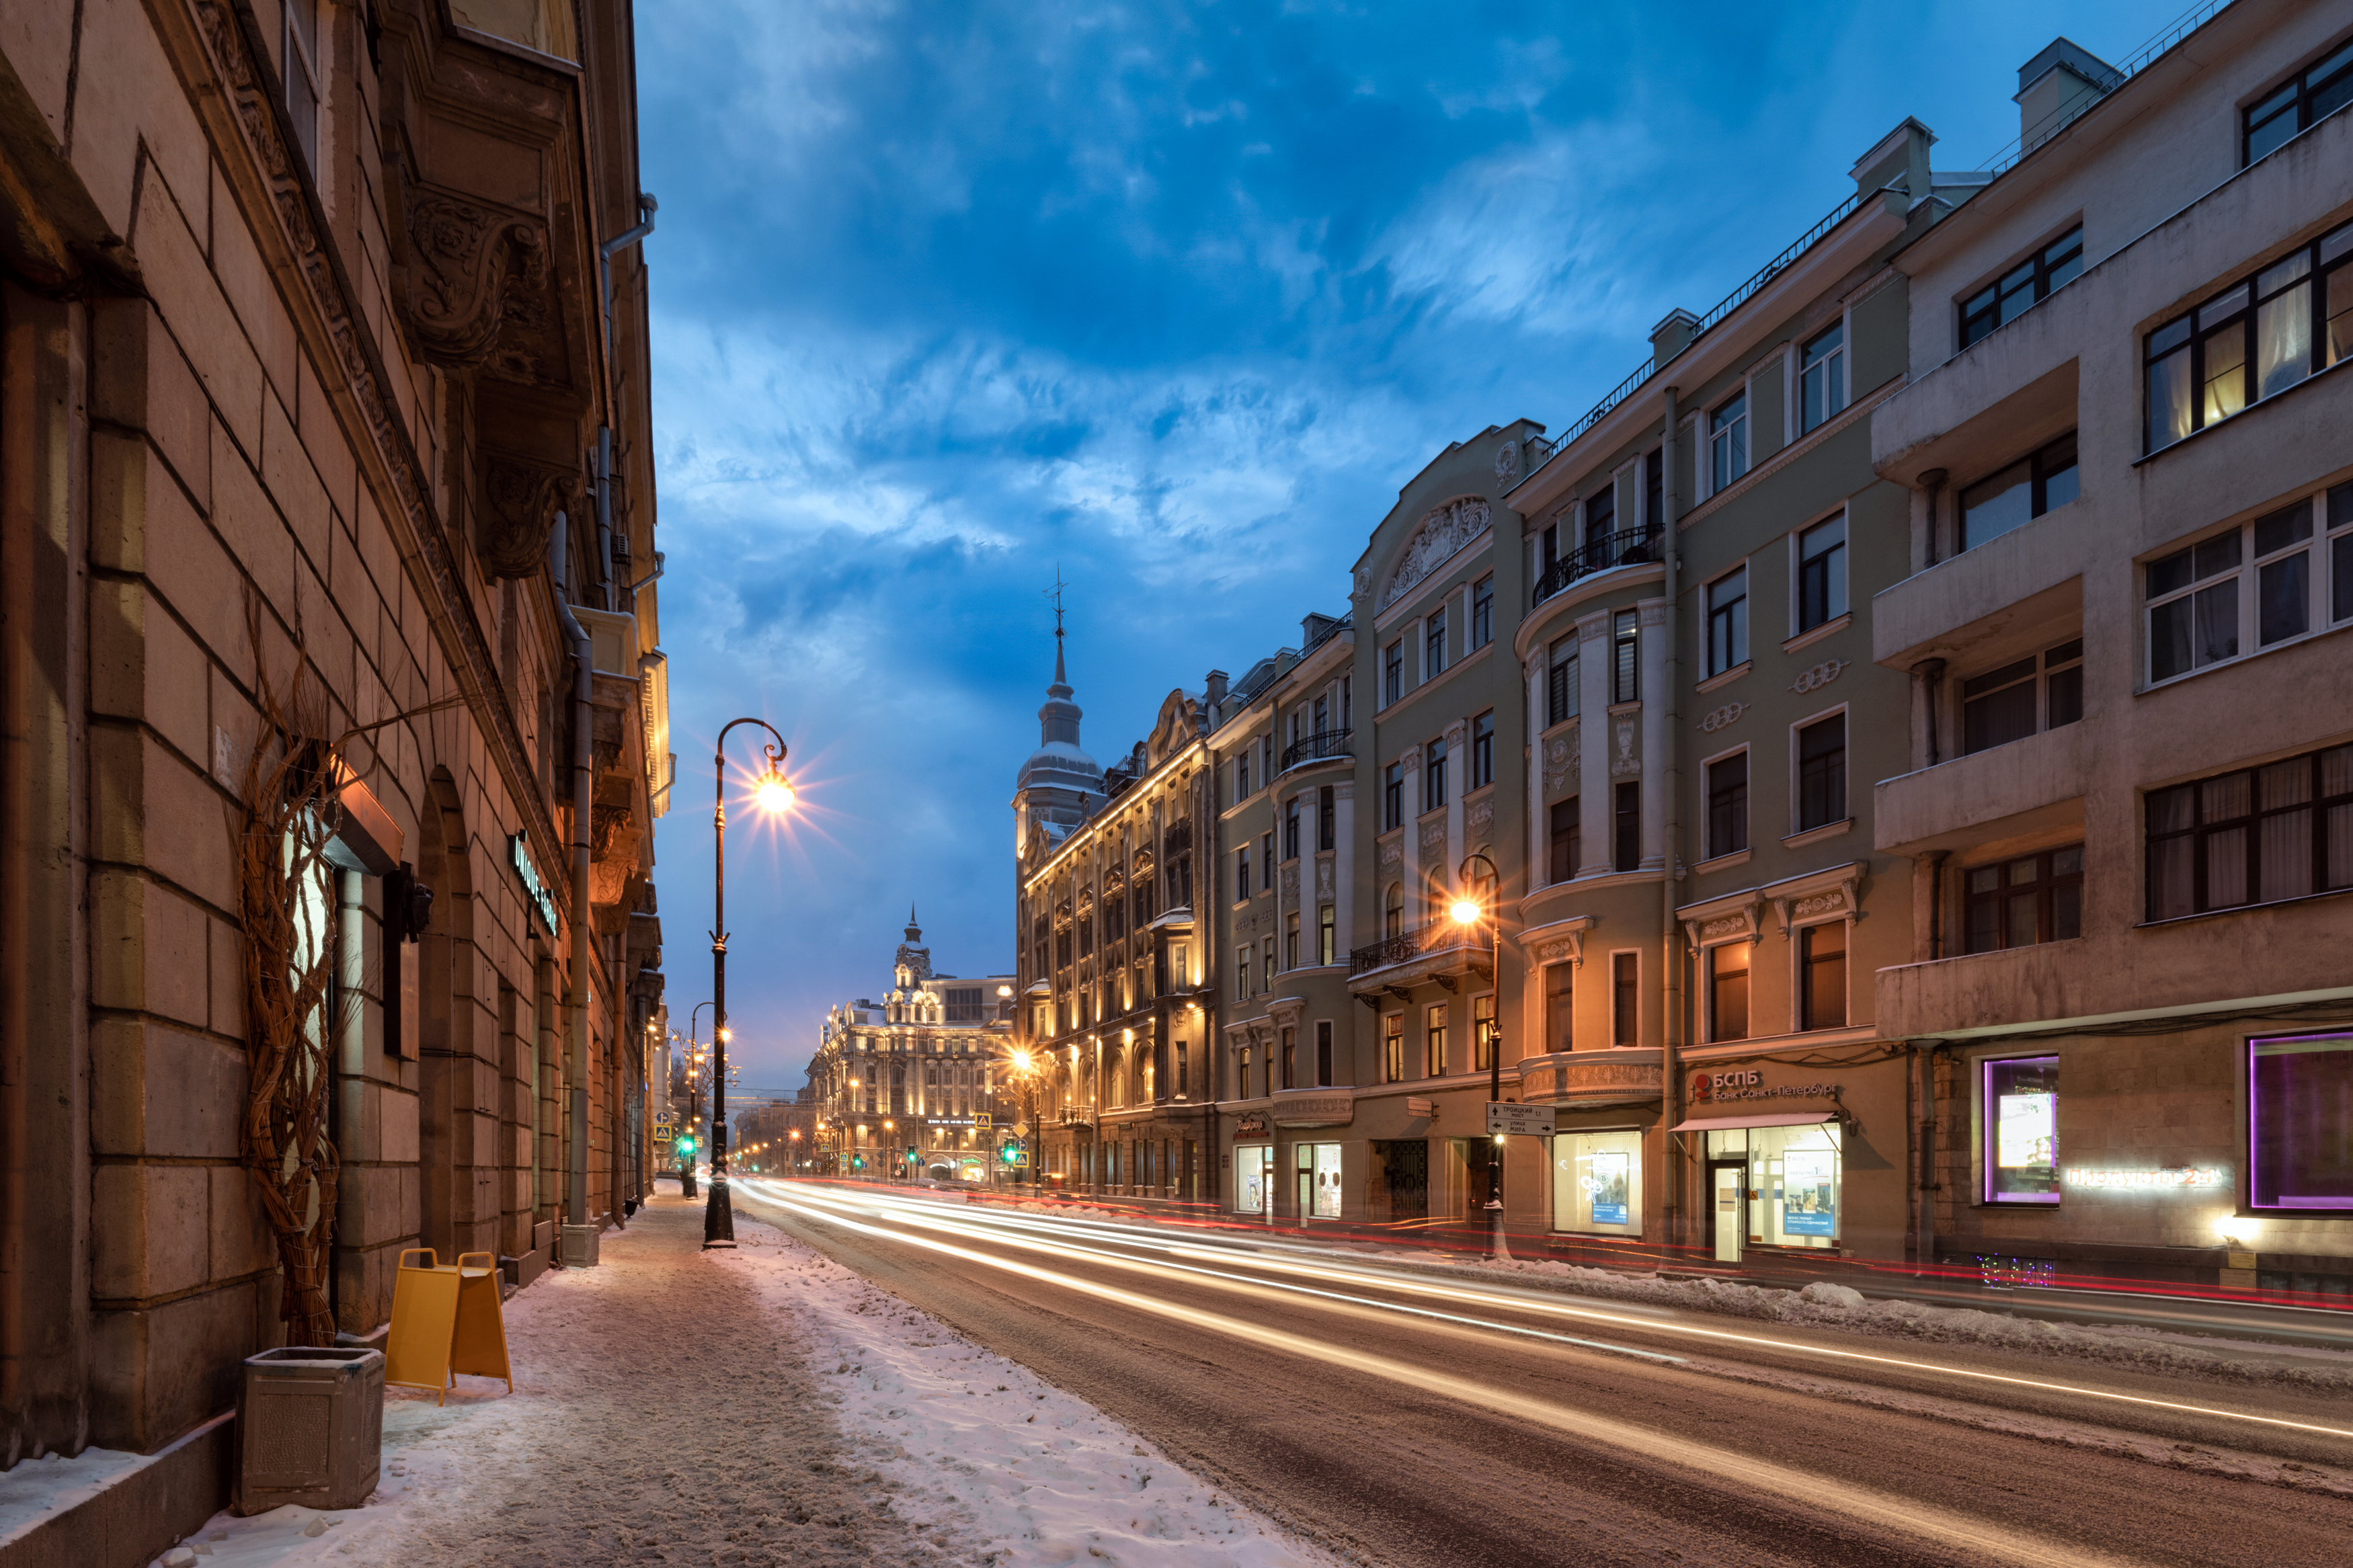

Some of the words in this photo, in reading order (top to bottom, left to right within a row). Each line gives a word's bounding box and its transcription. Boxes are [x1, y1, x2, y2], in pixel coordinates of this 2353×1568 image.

[516, 835, 539, 903] UNIQUE
[541, 886, 557, 936] FABRIC
[1714, 1070, 1760, 1087] БСПБ
[1714, 1090, 1738, 1100] Банк
[1740, 1083, 1837, 1098] Санкт-Петербург
[2069, 1169, 2182, 1186] Продукты
[2184, 1169, 2217, 1184] 24
